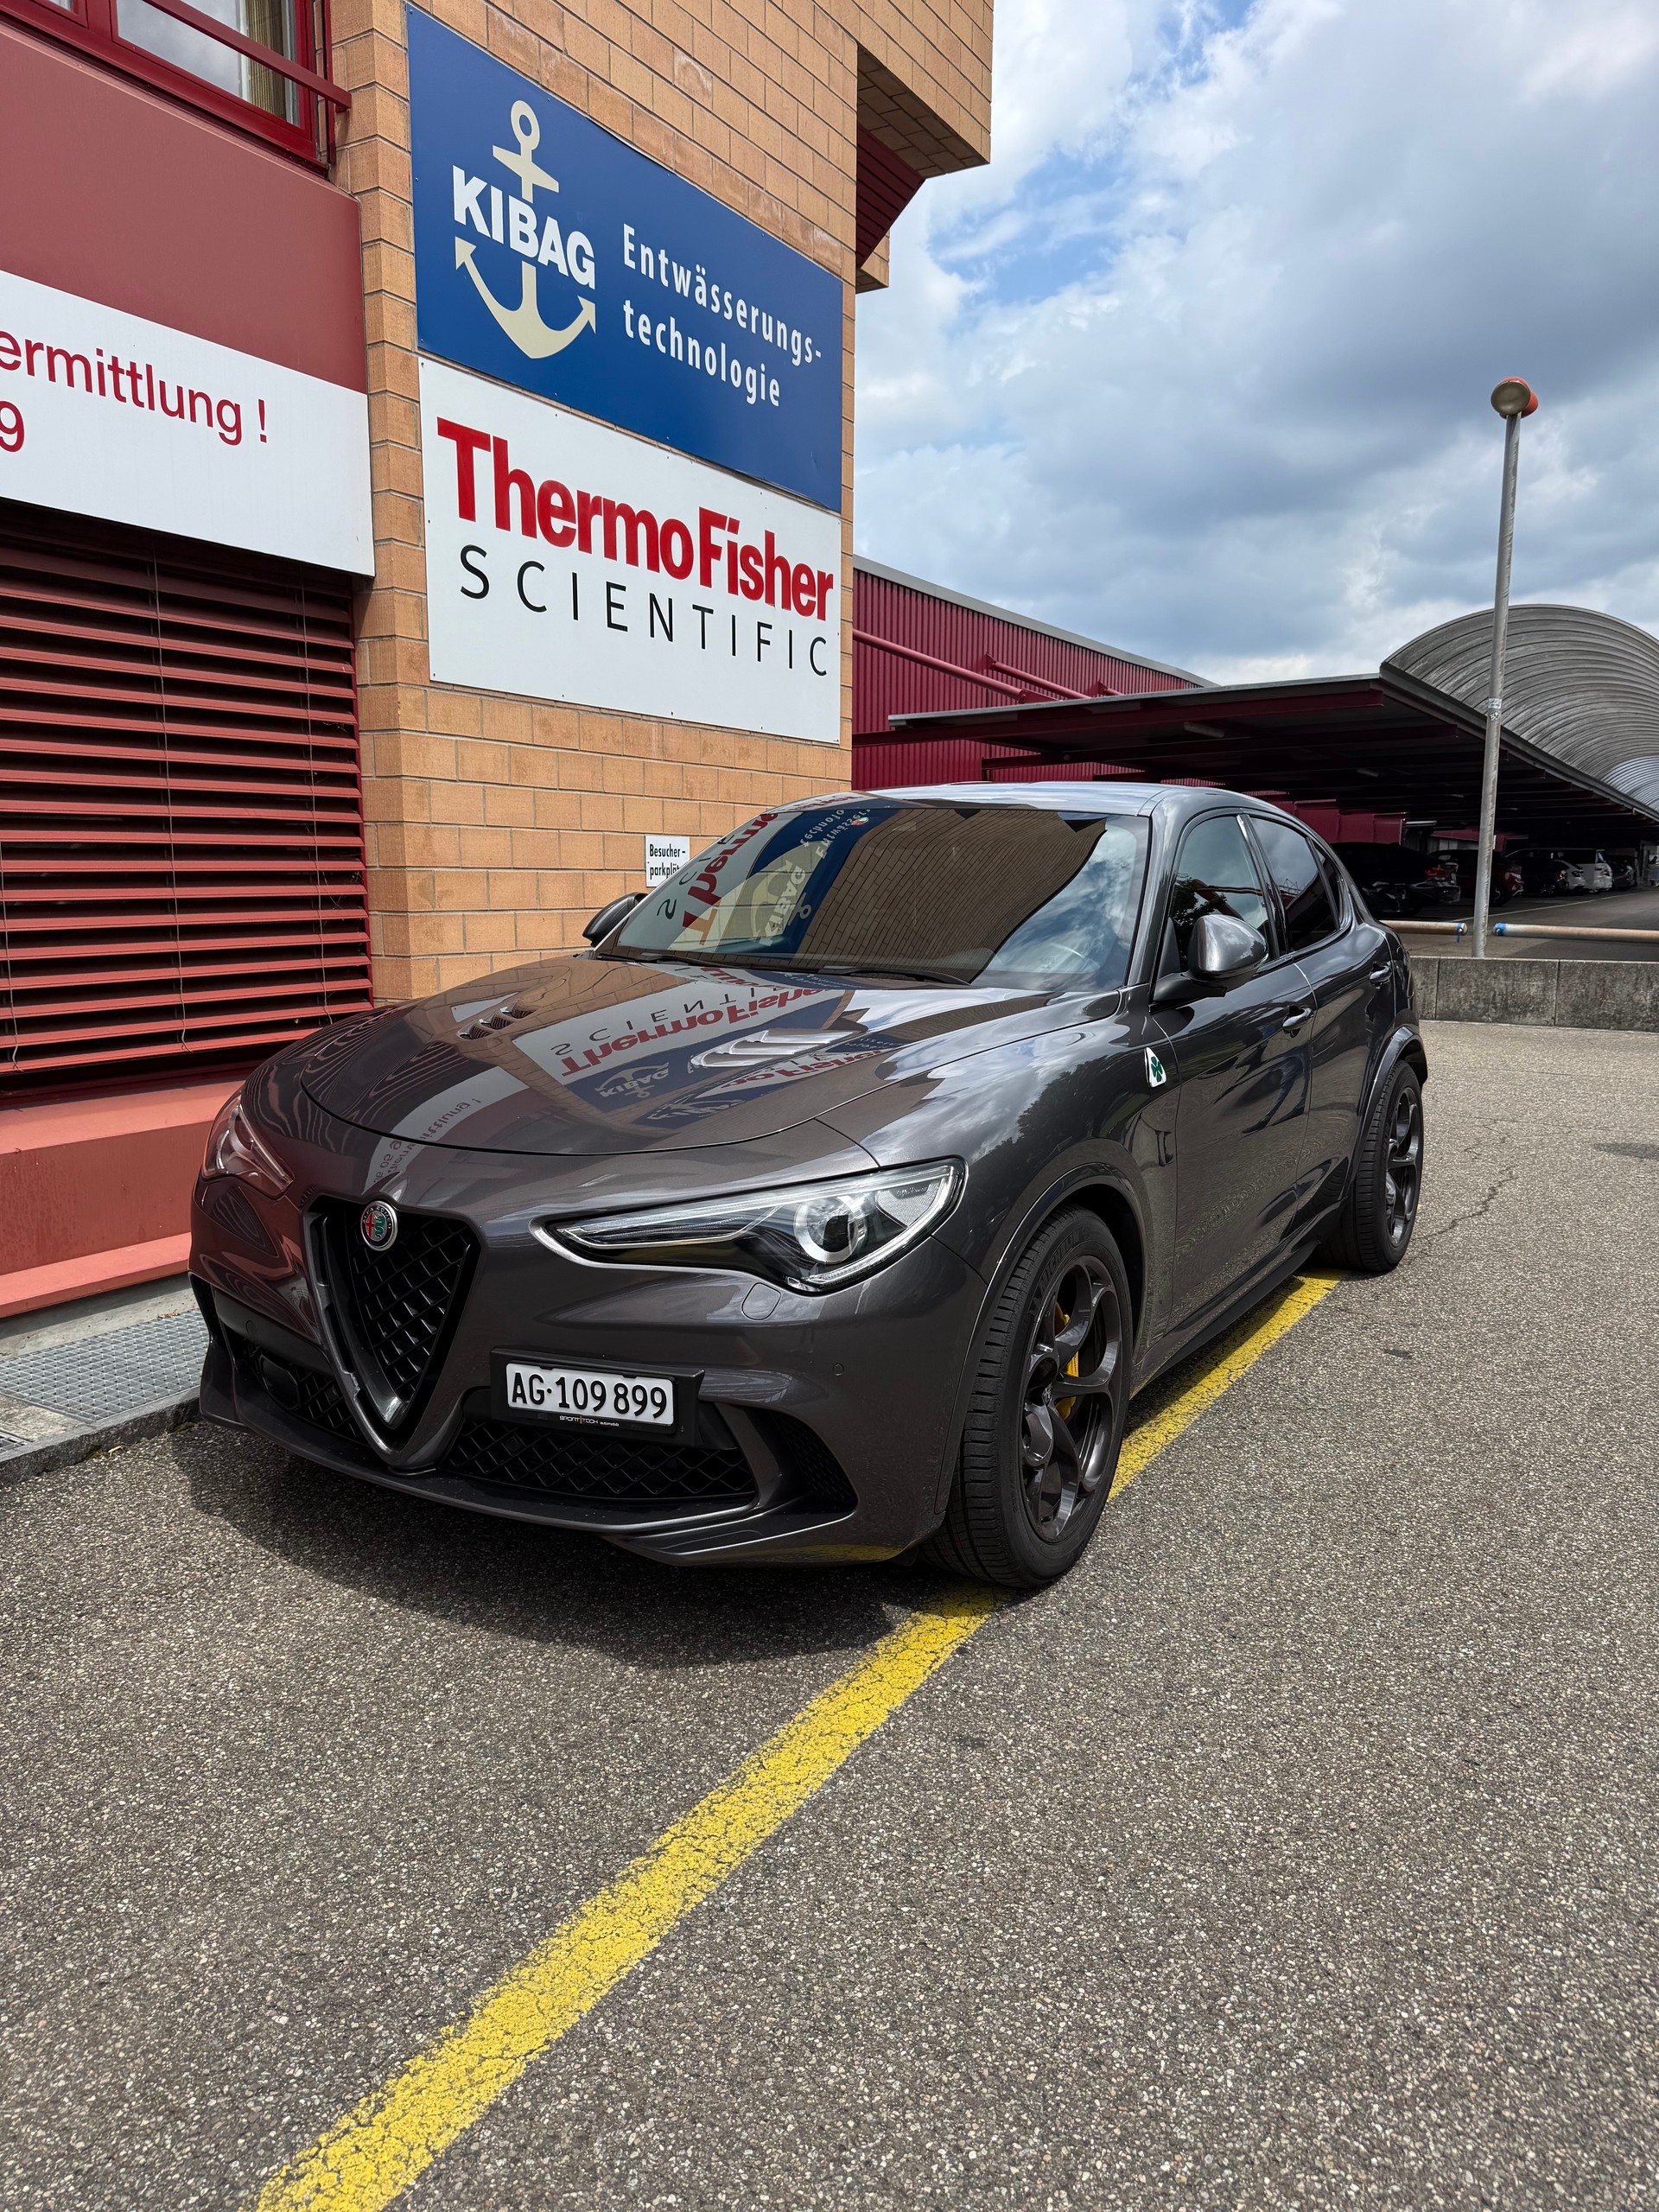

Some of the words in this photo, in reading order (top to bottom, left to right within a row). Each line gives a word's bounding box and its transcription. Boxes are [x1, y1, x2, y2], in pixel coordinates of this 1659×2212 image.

[453, 164, 595, 290] KIBAG
[623, 223, 823, 368] Entwässerungs-
[623, 299, 781, 407] technologie
[0, 330, 242, 447] ermittlung
[0, 400, 24, 453] 9
[460, 543, 828, 677] SCIENTIFIC
[613, 1382, 667, 1419] 899
